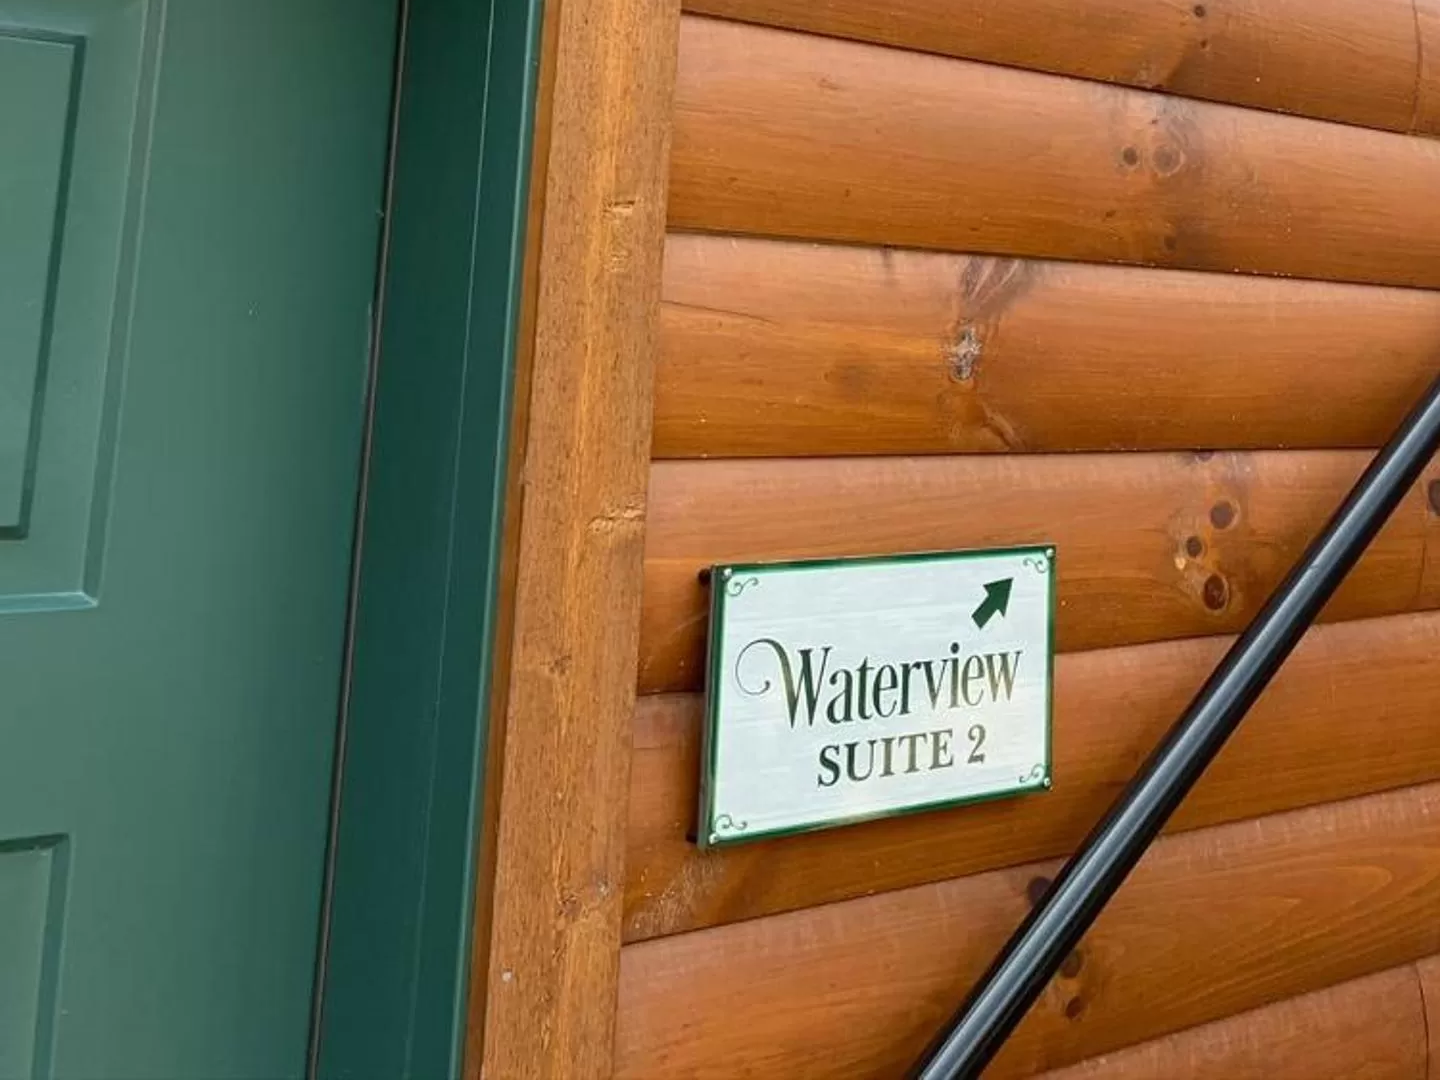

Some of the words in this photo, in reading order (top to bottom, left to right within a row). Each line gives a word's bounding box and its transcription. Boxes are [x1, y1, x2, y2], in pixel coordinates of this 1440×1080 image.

[735, 638, 1023, 729] Waterview
[818, 729, 953, 787] SUITE
[968, 724, 986, 764] 2
